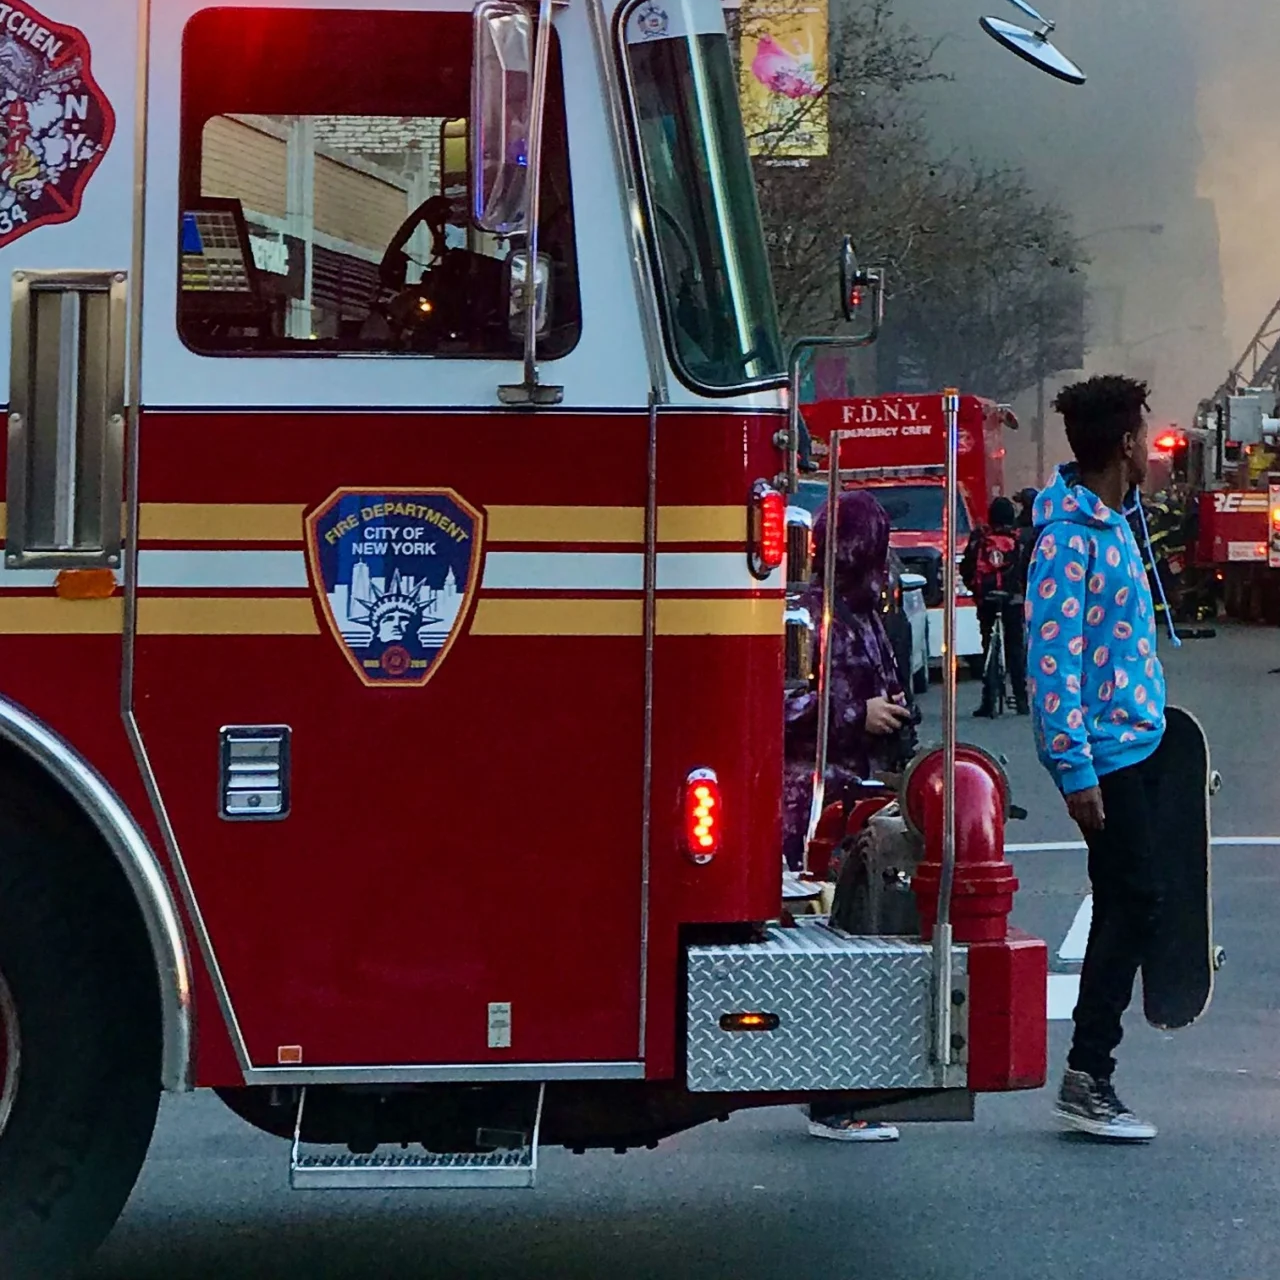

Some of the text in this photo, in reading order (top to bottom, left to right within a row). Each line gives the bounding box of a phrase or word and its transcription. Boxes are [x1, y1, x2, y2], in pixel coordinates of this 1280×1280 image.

[842, 402, 927, 423] F.D.N.Y.
[901, 425, 932, 436] CREW
[324, 502, 469, 545] FIRE DEPARTMENT
[364, 527, 425, 540] CITY OF
[352, 542, 436, 555] NEW YORK
